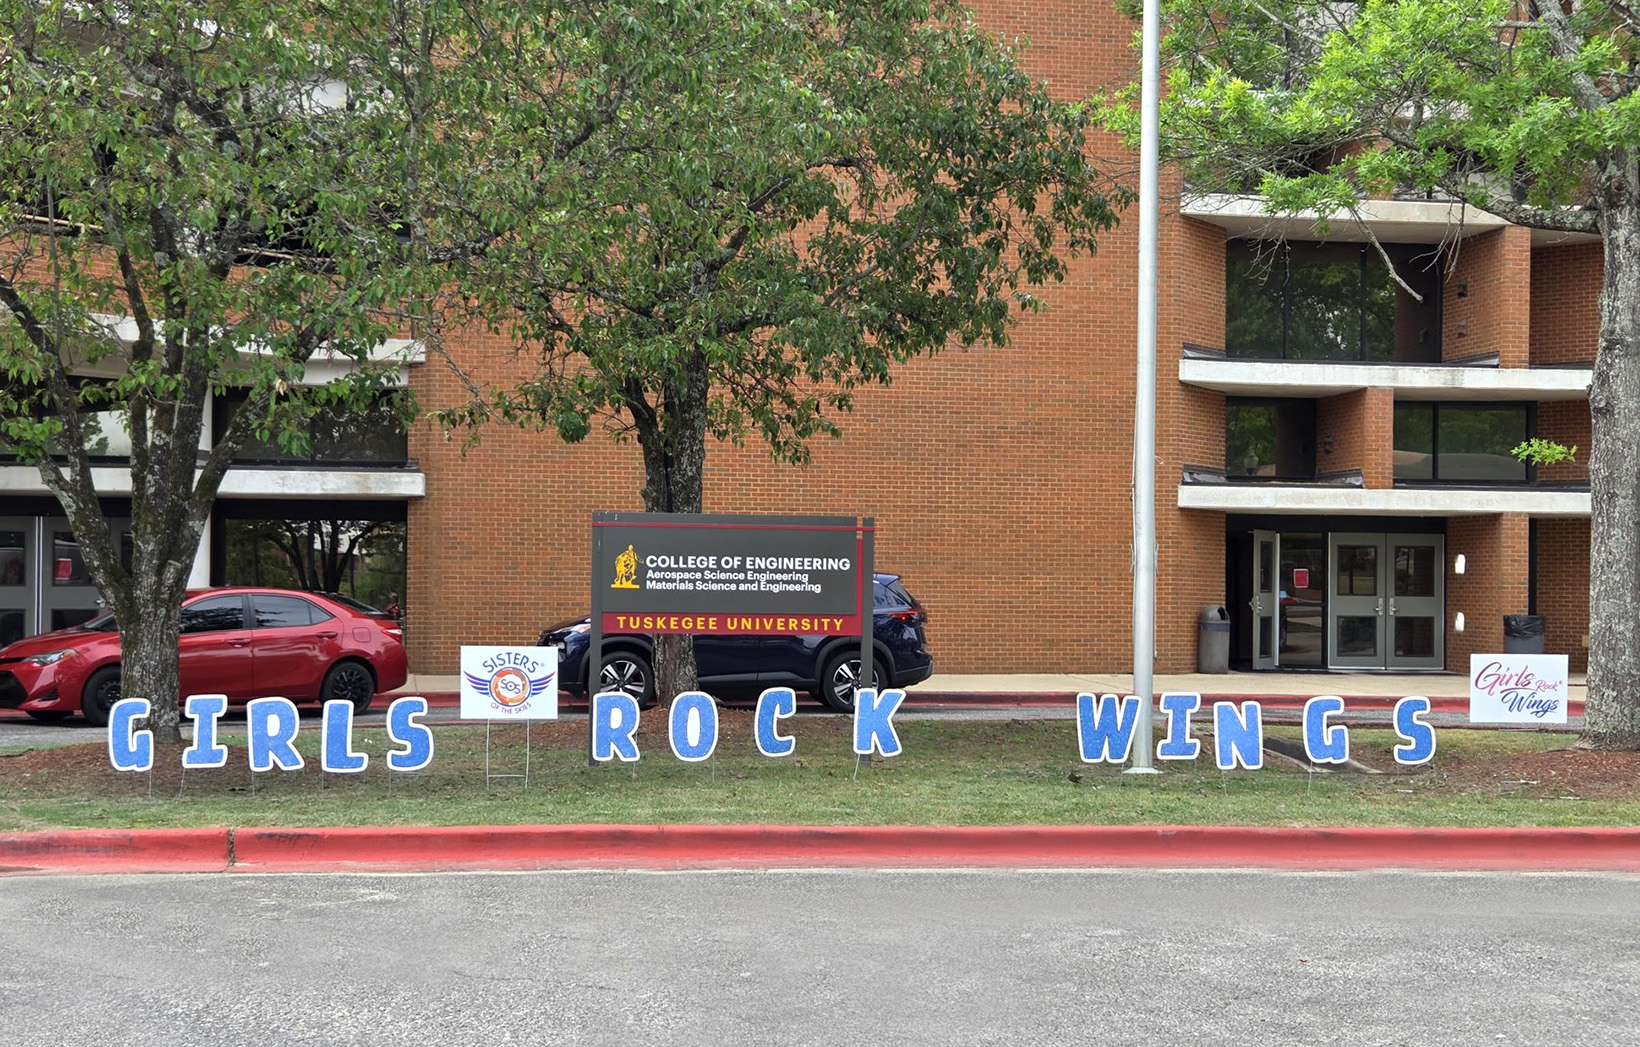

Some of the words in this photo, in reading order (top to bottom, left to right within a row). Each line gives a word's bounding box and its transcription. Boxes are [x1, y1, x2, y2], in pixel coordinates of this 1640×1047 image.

[646, 555, 717, 568] COLLEGE
[721, 556, 742, 569] OF
[745, 557, 851, 571] ENGINEERING
[646, 569, 702, 580] Aerospace
[703, 570, 745, 580] Science
[747, 571, 809, 582] Engineering
[646, 580, 694, 590] Materials
[695, 581, 737, 591] Science
[738, 581, 758, 591] and
[760, 582, 821, 593] Engineering
[617, 616, 718, 630] TUSKEGEE
[727, 617, 844, 631] UNIVERSITY
[482, 652, 539, 673] SISTERS
[1475, 661, 1534, 696] Girls
[1535, 680, 1559, 692] Rock
[1501, 691, 1559, 718] Wings
[108, 694, 435, 773] GIRLS
[592, 687, 907, 763] ROCK
[1076, 691, 1437, 770] WINGS
